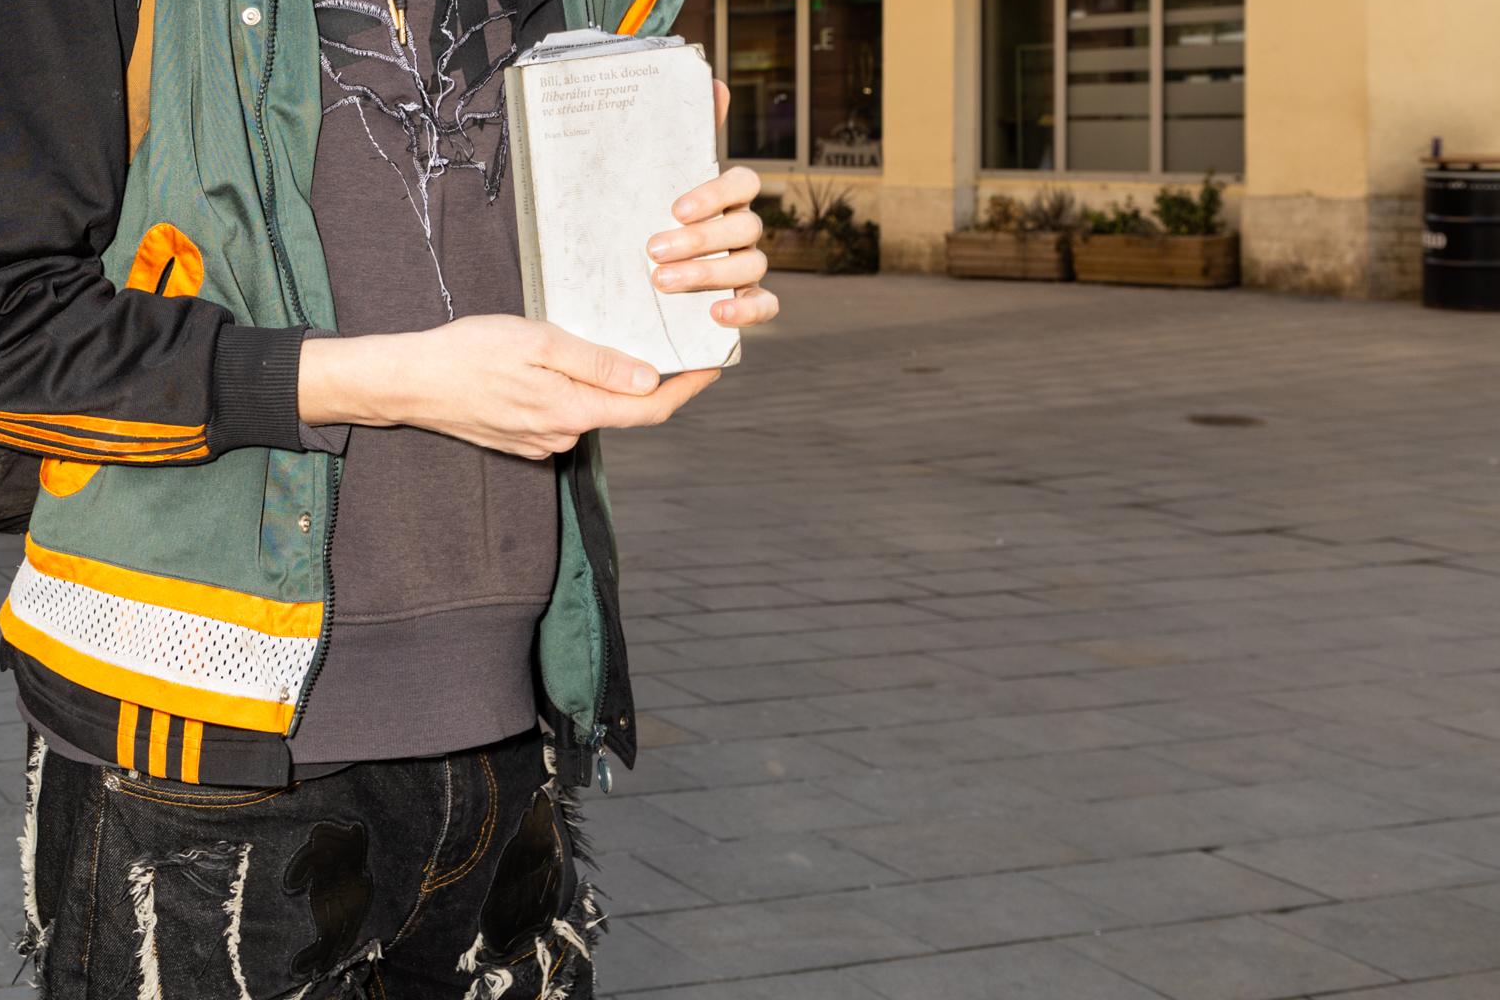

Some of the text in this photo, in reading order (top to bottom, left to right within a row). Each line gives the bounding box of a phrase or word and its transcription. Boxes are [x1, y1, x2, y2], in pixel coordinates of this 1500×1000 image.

[564, 73, 581, 85] ale
[583, 73, 597, 83] ne
[599, 69, 618, 80] tak
[621, 64, 659, 78] docela
[594, 84, 639, 100] vzpoura
[543, 108, 555, 117] ve
